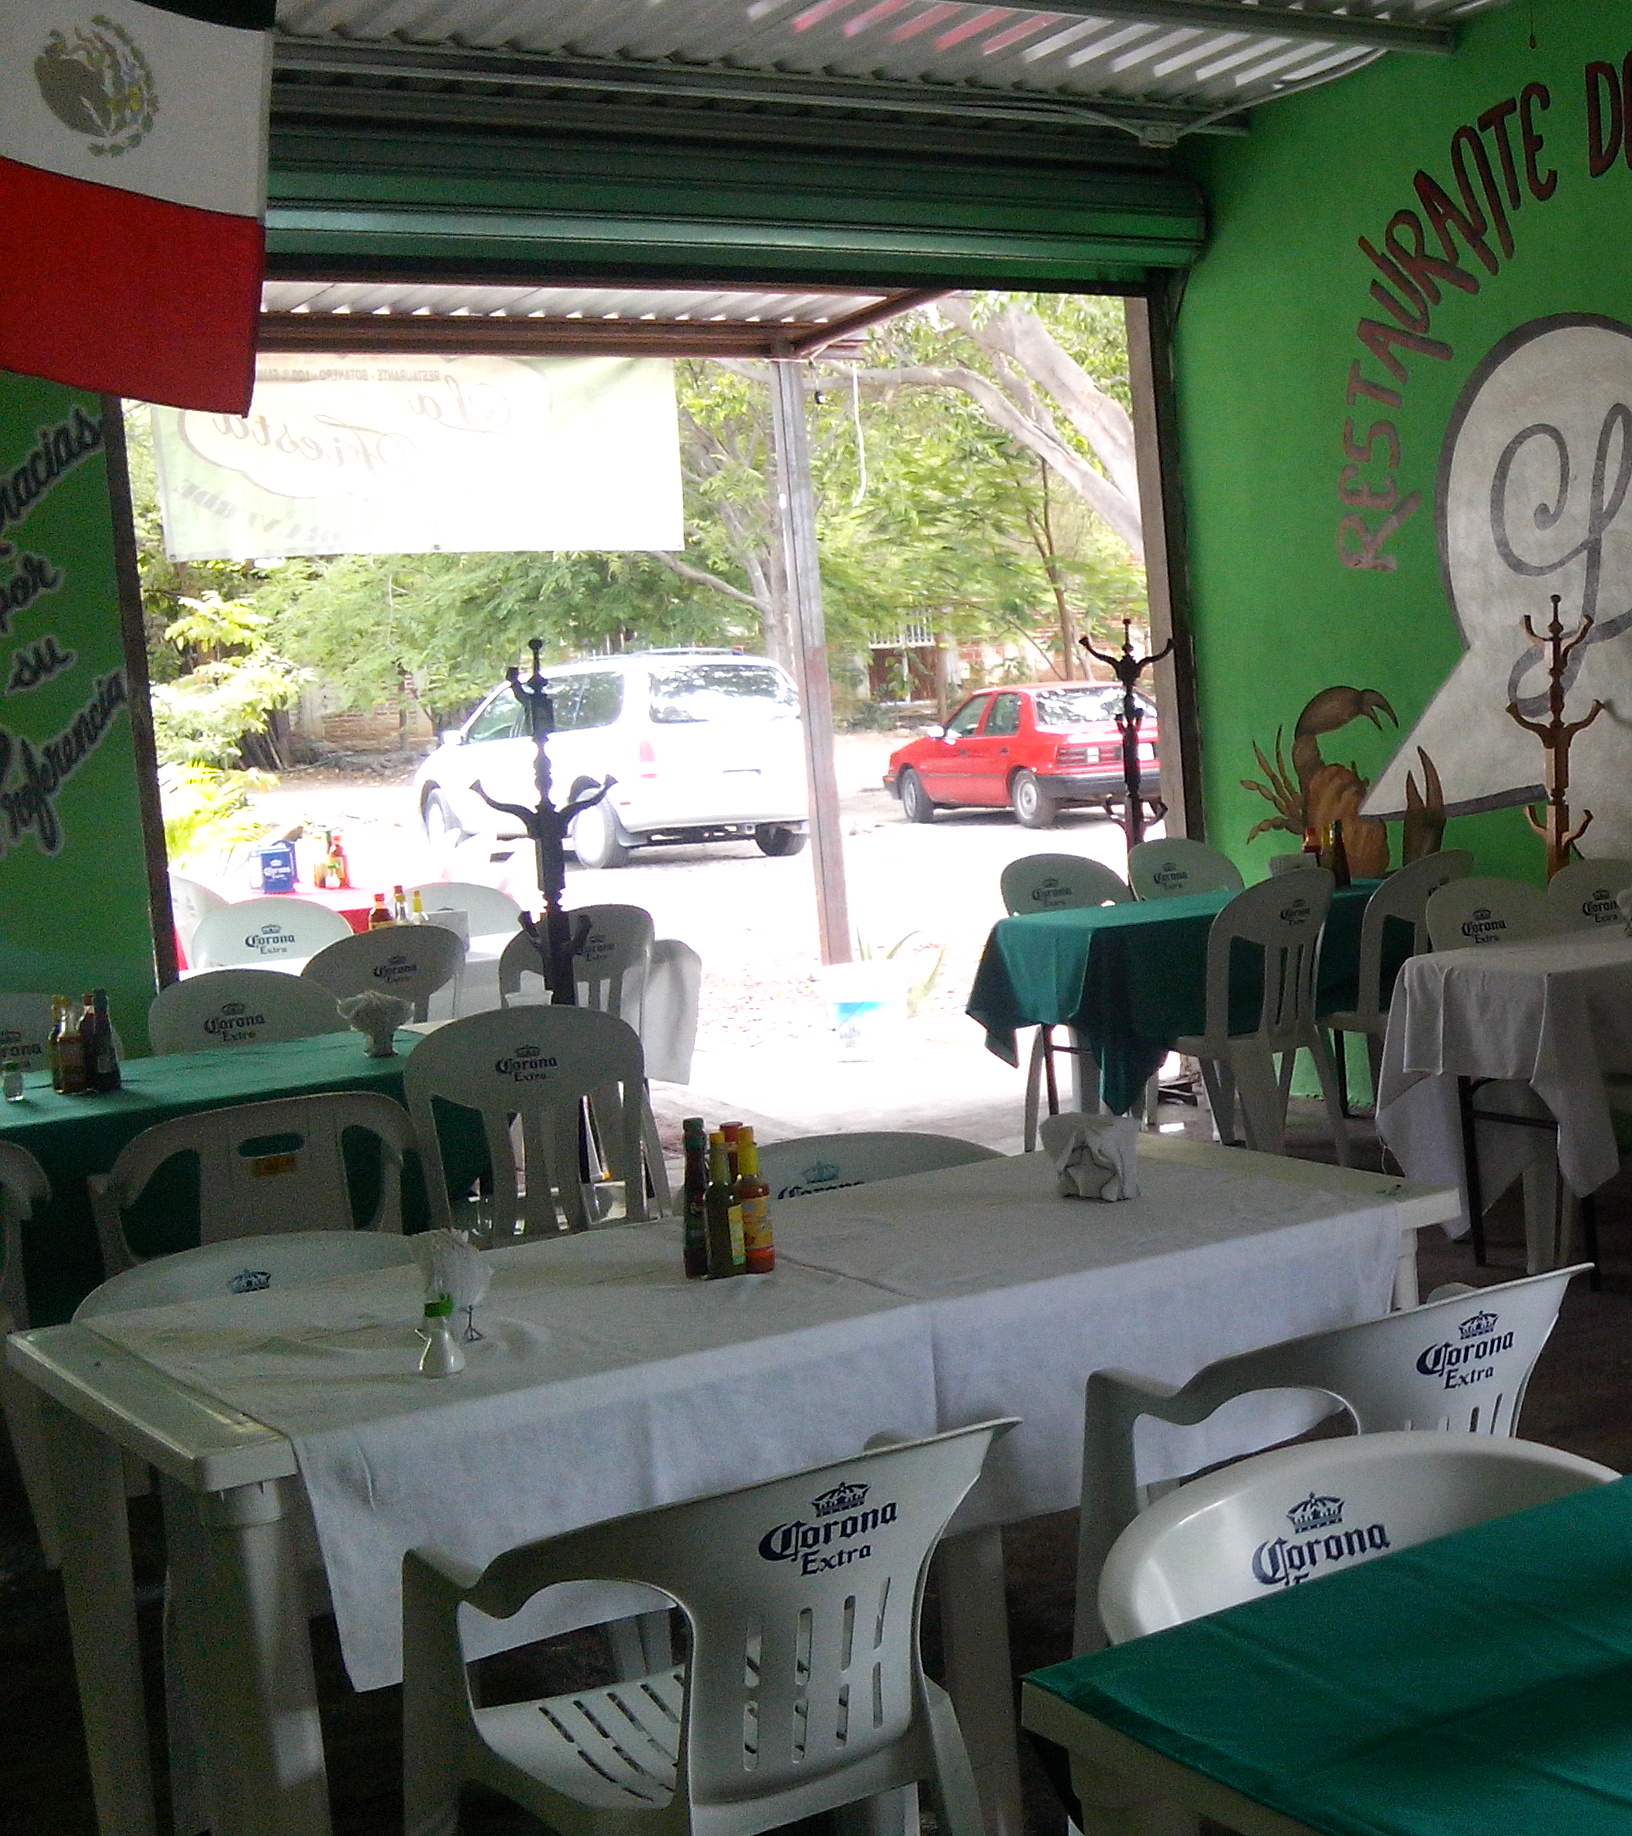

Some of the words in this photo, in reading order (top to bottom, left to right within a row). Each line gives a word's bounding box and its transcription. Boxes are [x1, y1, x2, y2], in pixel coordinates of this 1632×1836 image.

[1337, 82, 1557, 572] RESTAURANTE
[0, 407, 105, 536] racias
[1582, 900, 1619, 916] Coron
[1462, 920, 1506, 937] Corona
[246, 934, 296, 949] Corona
[204, 1013, 266, 1035] Corona
[0, 1043, 43, 1059] rona
[495, 1056, 558, 1075] Corona
[1417, 1331, 1514, 1377] Corona
[1444, 1365, 1494, 1390] Extra
[758, 1501, 898, 1562] Corona
[801, 1543, 872, 1576] Extra
[1252, 1523, 1391, 1586] Corona
